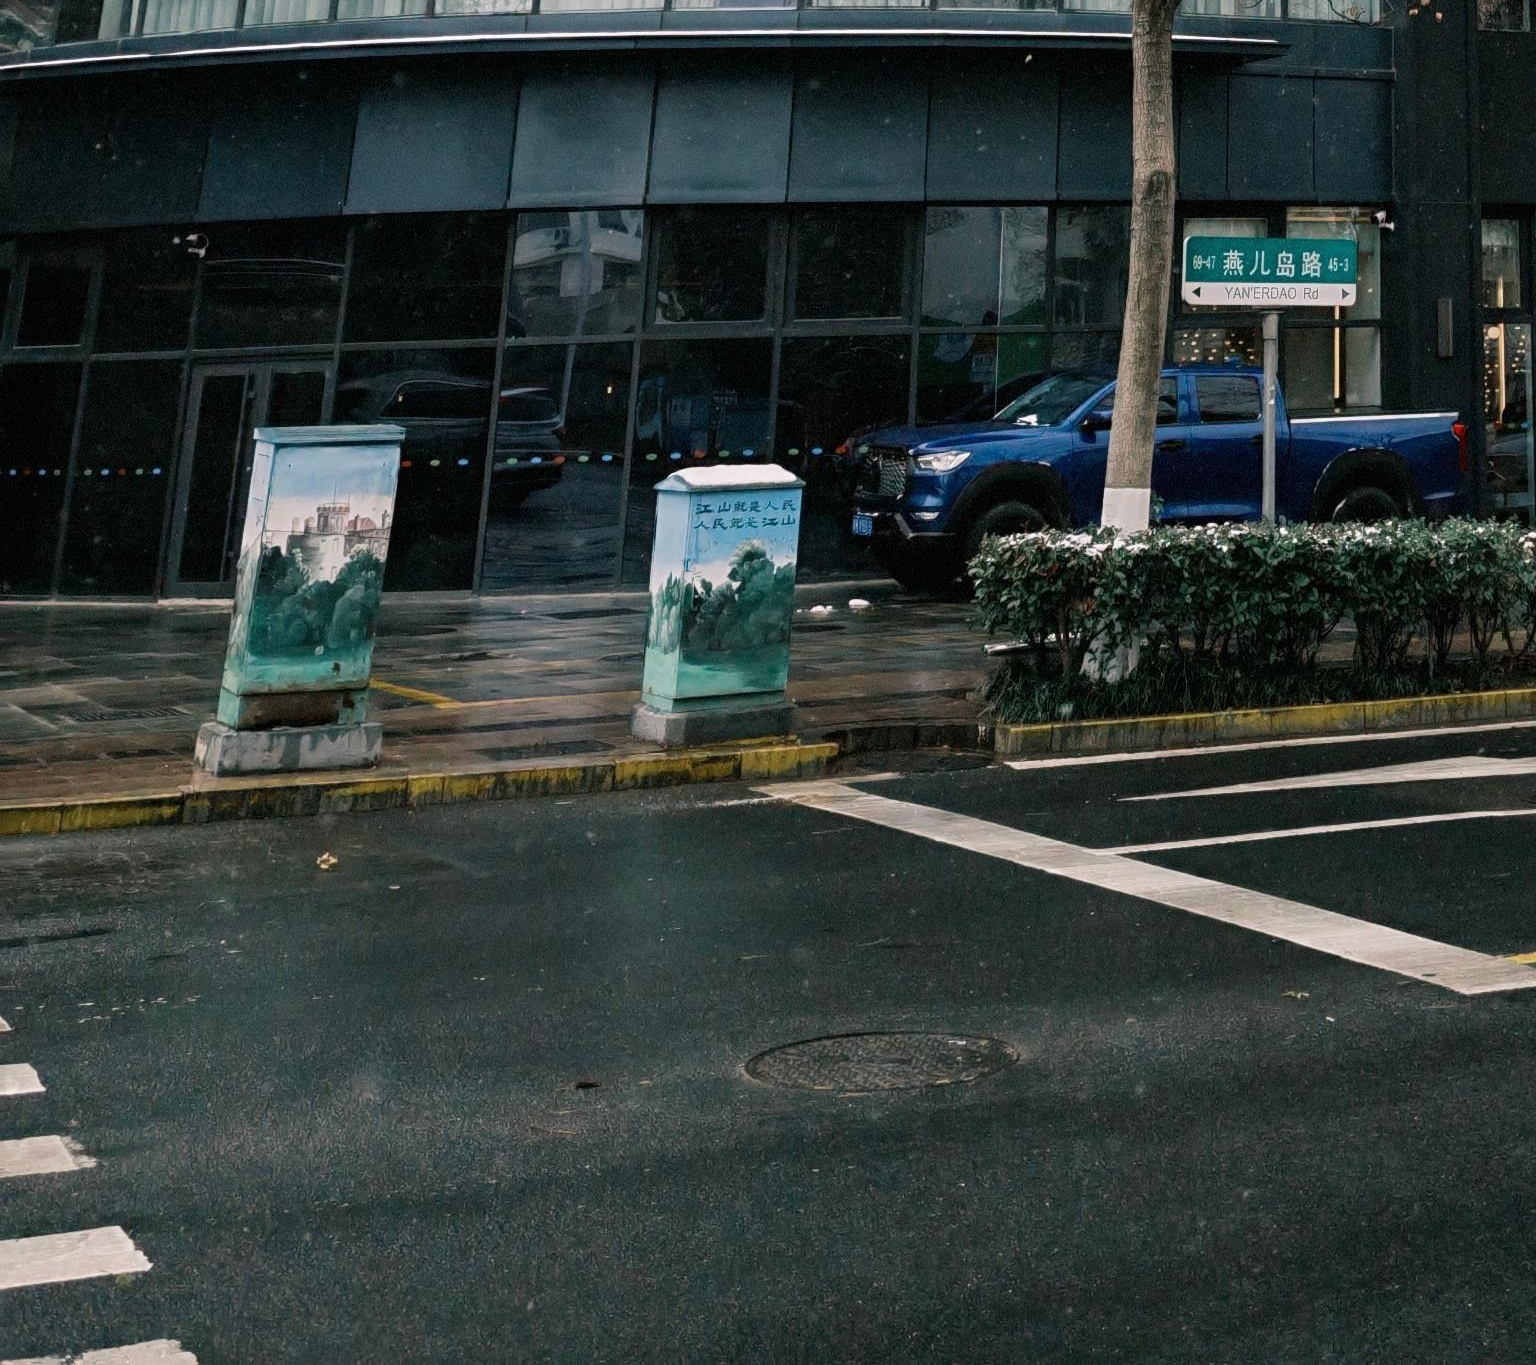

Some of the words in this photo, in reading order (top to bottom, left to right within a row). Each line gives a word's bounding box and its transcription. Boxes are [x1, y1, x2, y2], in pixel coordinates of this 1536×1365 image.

[1192, 254, 1216, 270] 69-47
[1222, 249, 1322, 278] 燕儿岛路
[1328, 257, 1349, 272] 45-3
[1225, 286, 1297, 300] YAN'ERDAO
[1303, 287, 1319, 300] Rd
[695, 499, 797, 515] 江山就是人民
